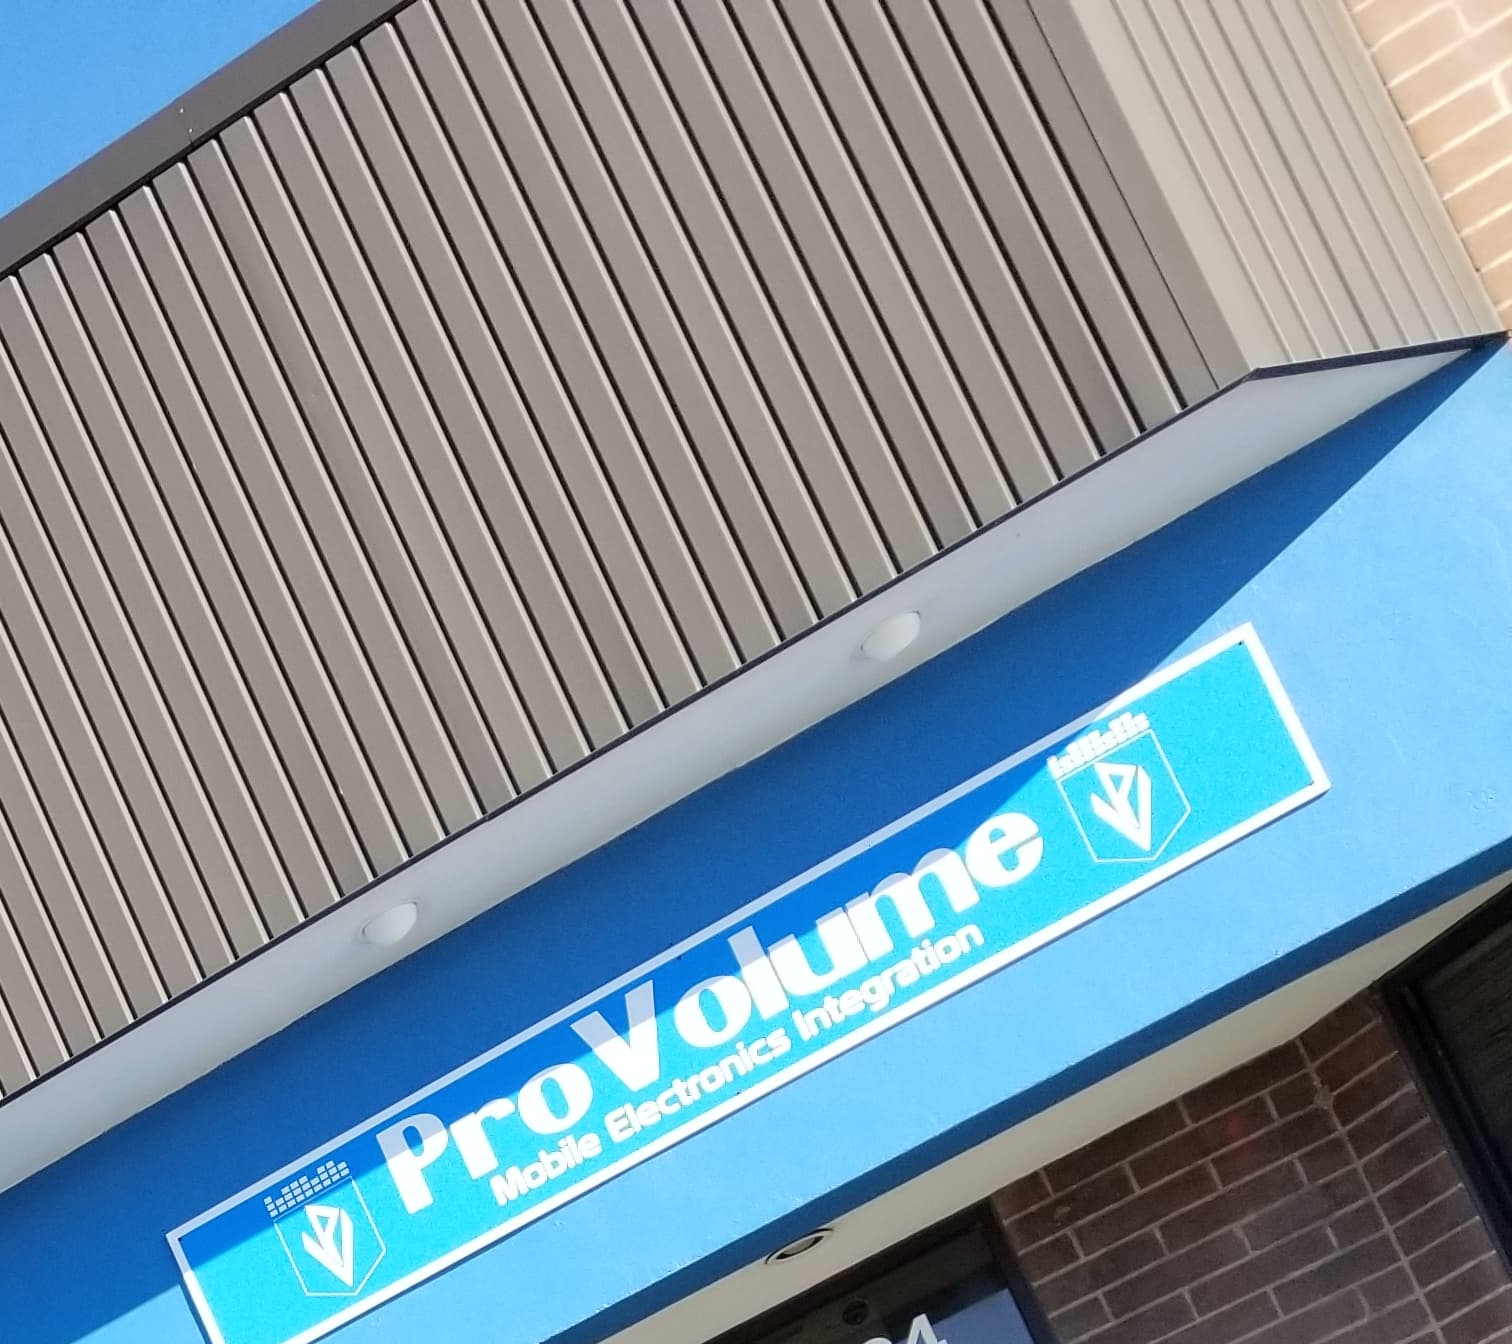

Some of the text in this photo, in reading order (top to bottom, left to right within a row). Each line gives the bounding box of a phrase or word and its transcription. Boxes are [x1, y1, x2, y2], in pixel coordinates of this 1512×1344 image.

[376, 812, 1043, 1213] ProVolume
[490, 922, 985, 1207] Mobile Electronics Integration
